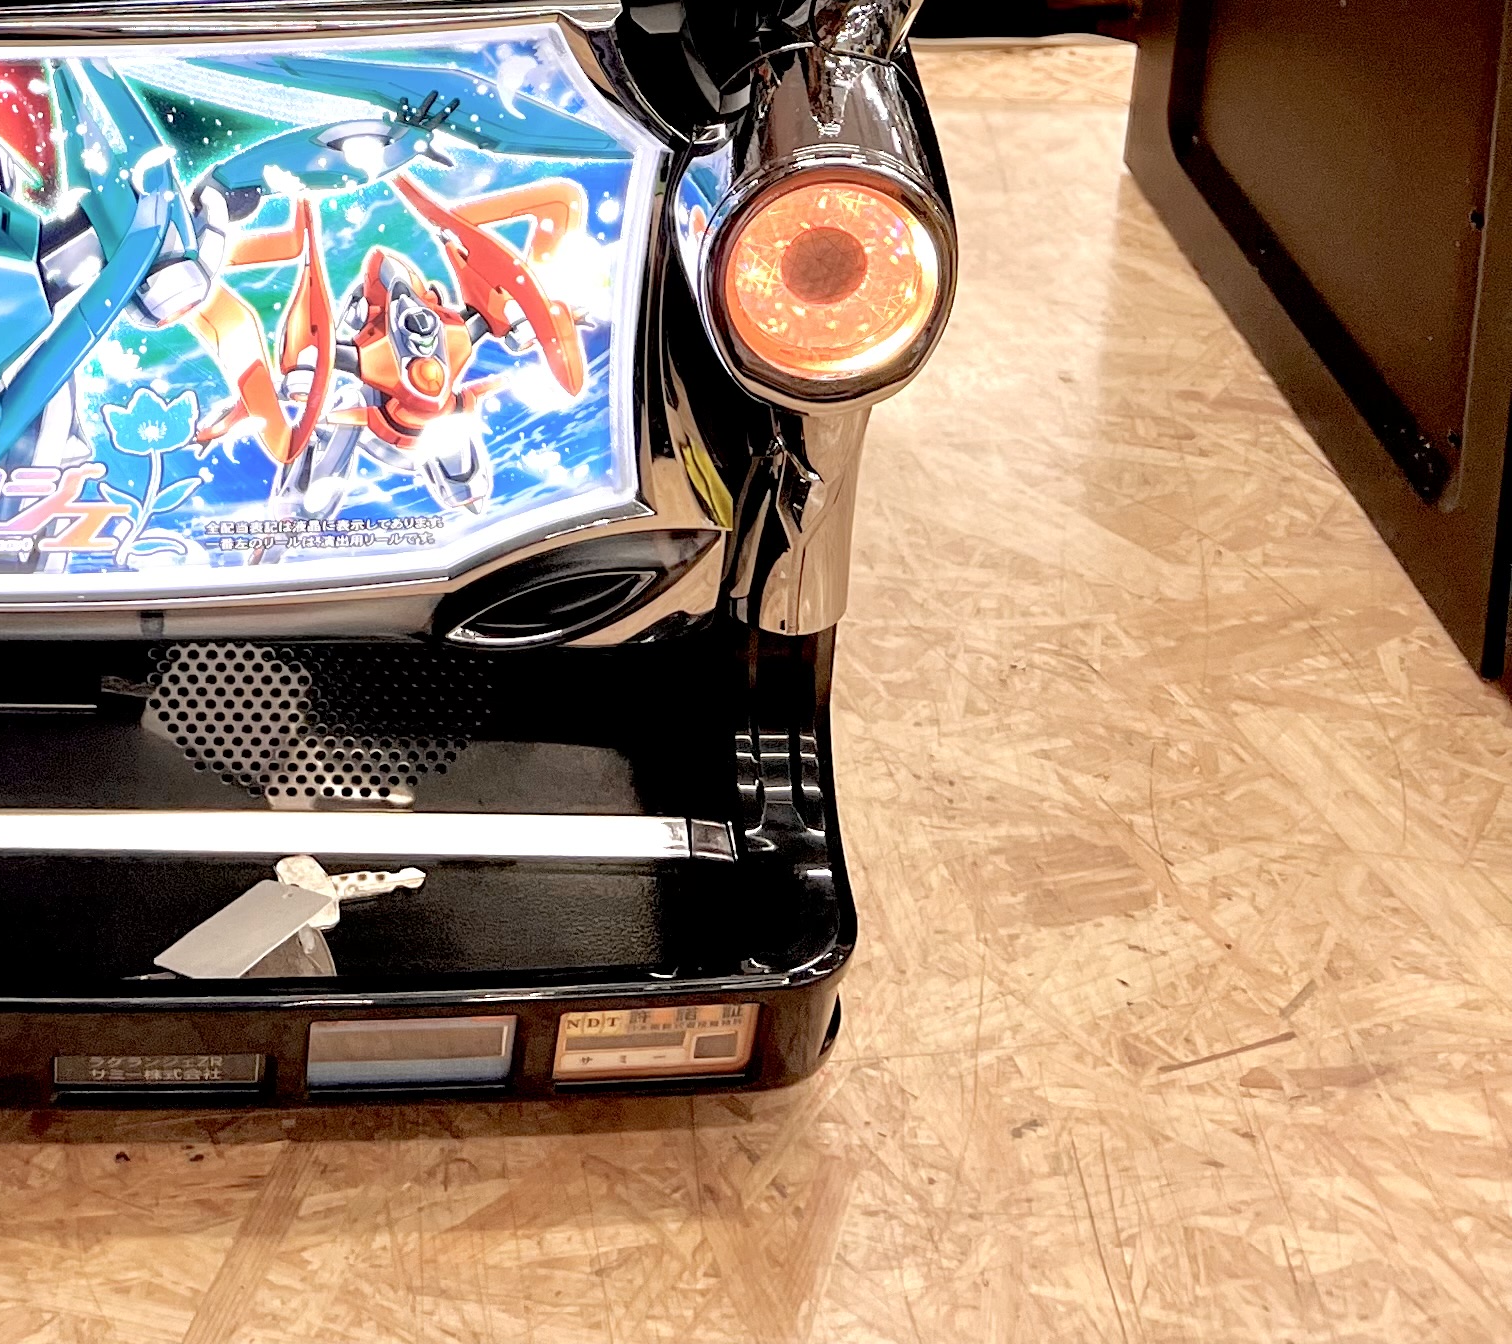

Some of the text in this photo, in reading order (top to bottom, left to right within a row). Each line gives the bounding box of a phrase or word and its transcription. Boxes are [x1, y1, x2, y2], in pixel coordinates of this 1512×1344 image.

[91, 1068, 224, 1080] サミー株式会社
